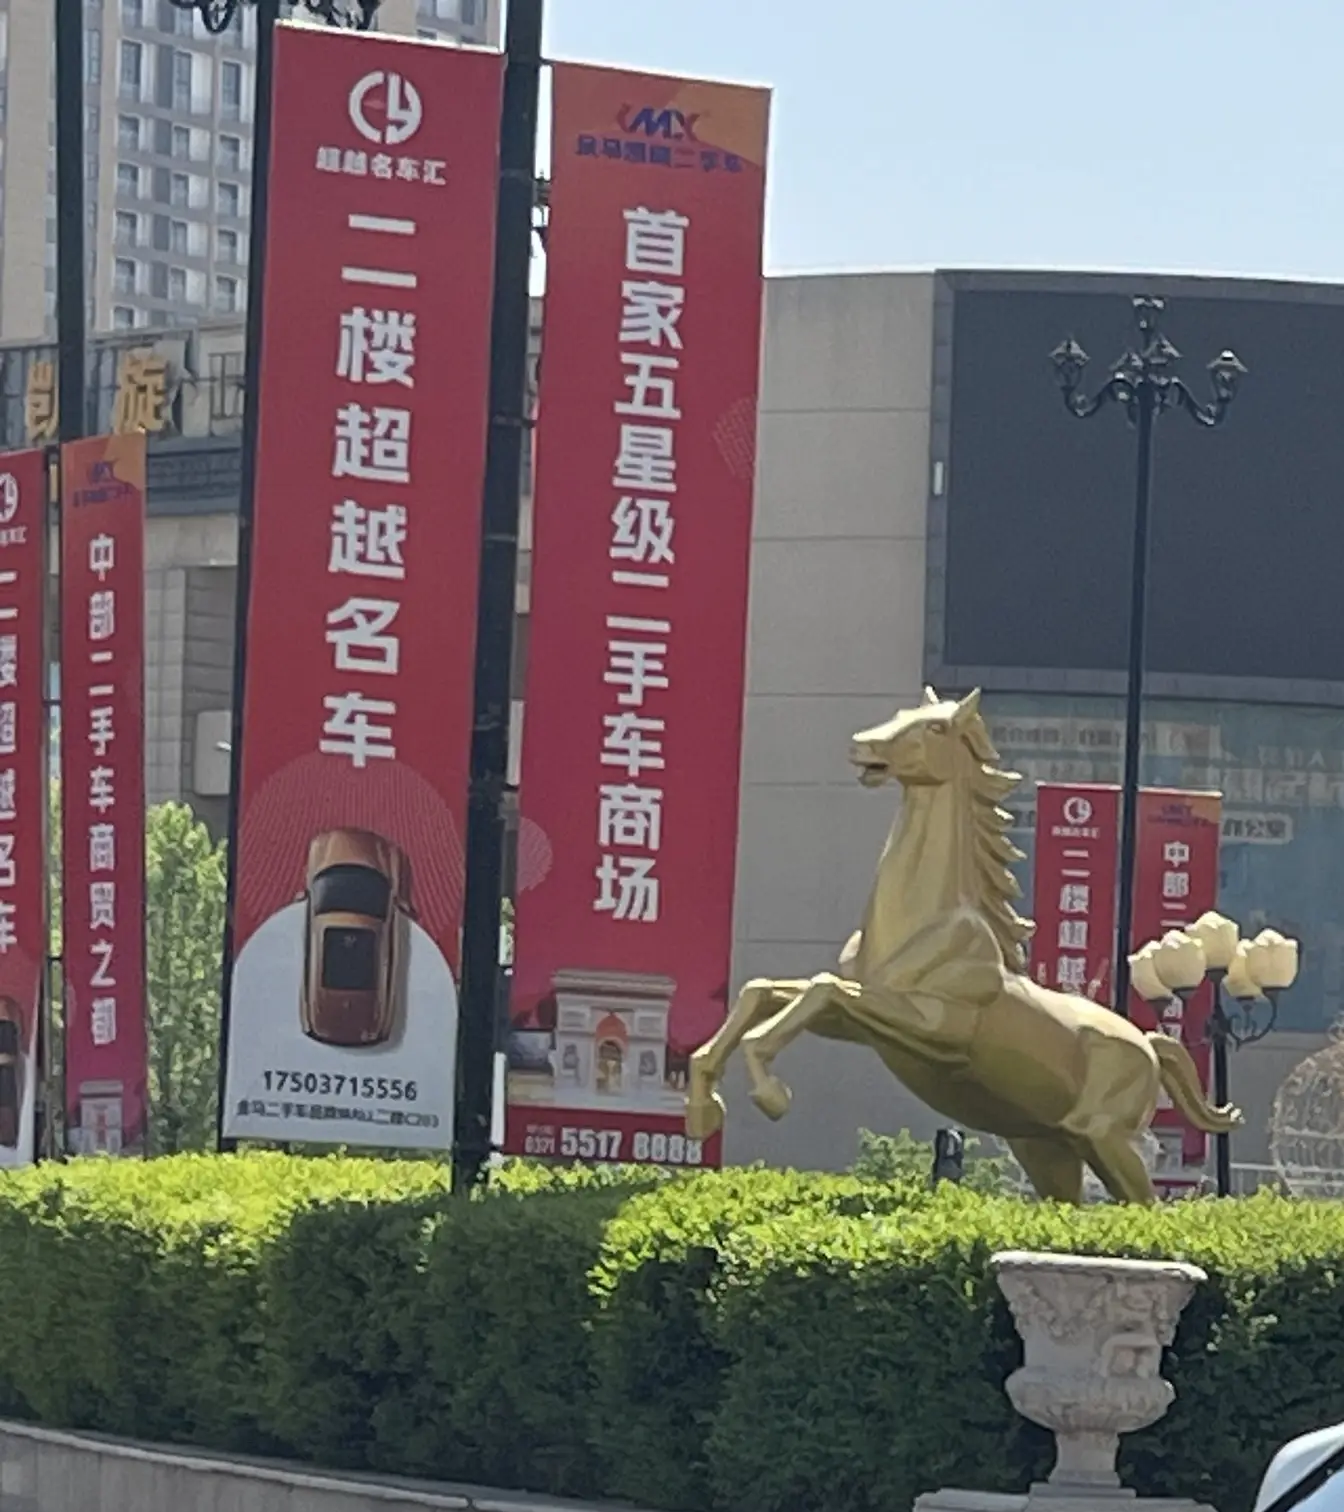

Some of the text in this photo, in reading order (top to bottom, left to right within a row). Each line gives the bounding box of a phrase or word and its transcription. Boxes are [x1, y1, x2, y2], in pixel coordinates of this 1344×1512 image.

[319, 213, 418, 768] 二楼超越名车
[593, 206, 690, 923] 首家五星级二手车商场
[263, 1070, 418, 1101] 17503715556
[560, 1127, 623, 1159] 5517
